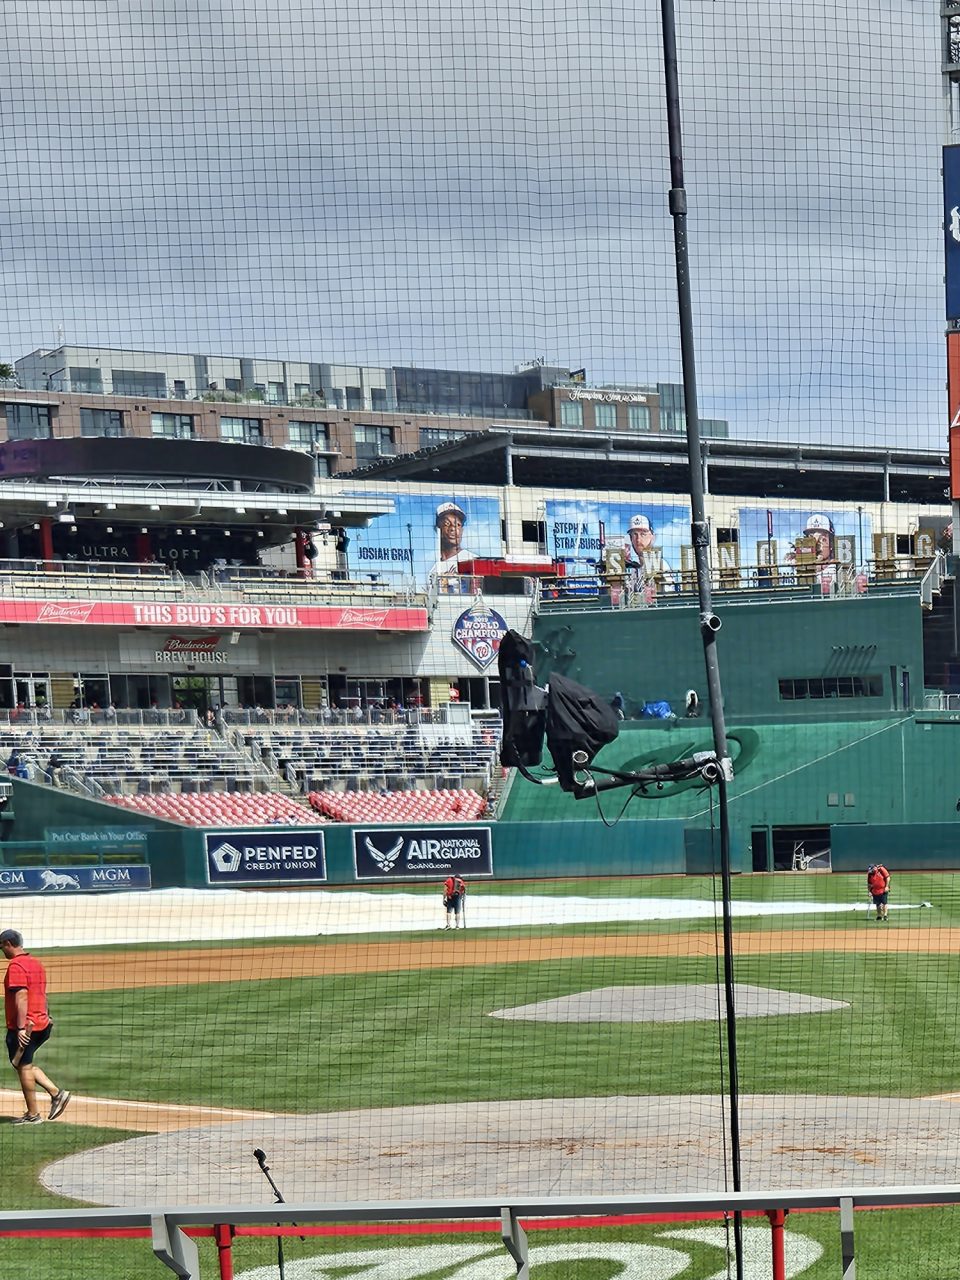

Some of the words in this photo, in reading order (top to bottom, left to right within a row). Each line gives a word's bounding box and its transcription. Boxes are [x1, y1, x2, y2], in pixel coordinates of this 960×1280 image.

[82, 545, 129, 558] ULTRA
[159, 549, 200, 560] LOFT
[358, 546, 389, 561] JOSIAH
[391, 547, 414, 562] GRAY
[41, 603, 90, 618] Budweiser
[133, 605, 173, 623] THIS
[176, 605, 226, 624] BUD'S
[230, 606, 261, 625] FOR
[264, 607, 302, 626] YOU.
[341, 610, 386, 624] Budweiser
[463, 620, 499, 629] WORLD
[166, 638, 217, 651] Budweiser
[155, 651, 188, 663] BREW
[192, 651, 229, 664] HOUSE
[407, 840, 441, 860] AIR
[441, 839, 481, 848] NATIONAL
[245, 846, 318, 861] PENFED
[441, 847, 481, 860] GUARD
[245, 862, 281, 870] CREDIT
[285, 861, 317, 870] UNION
[92, 869, 131, 882] MGM
